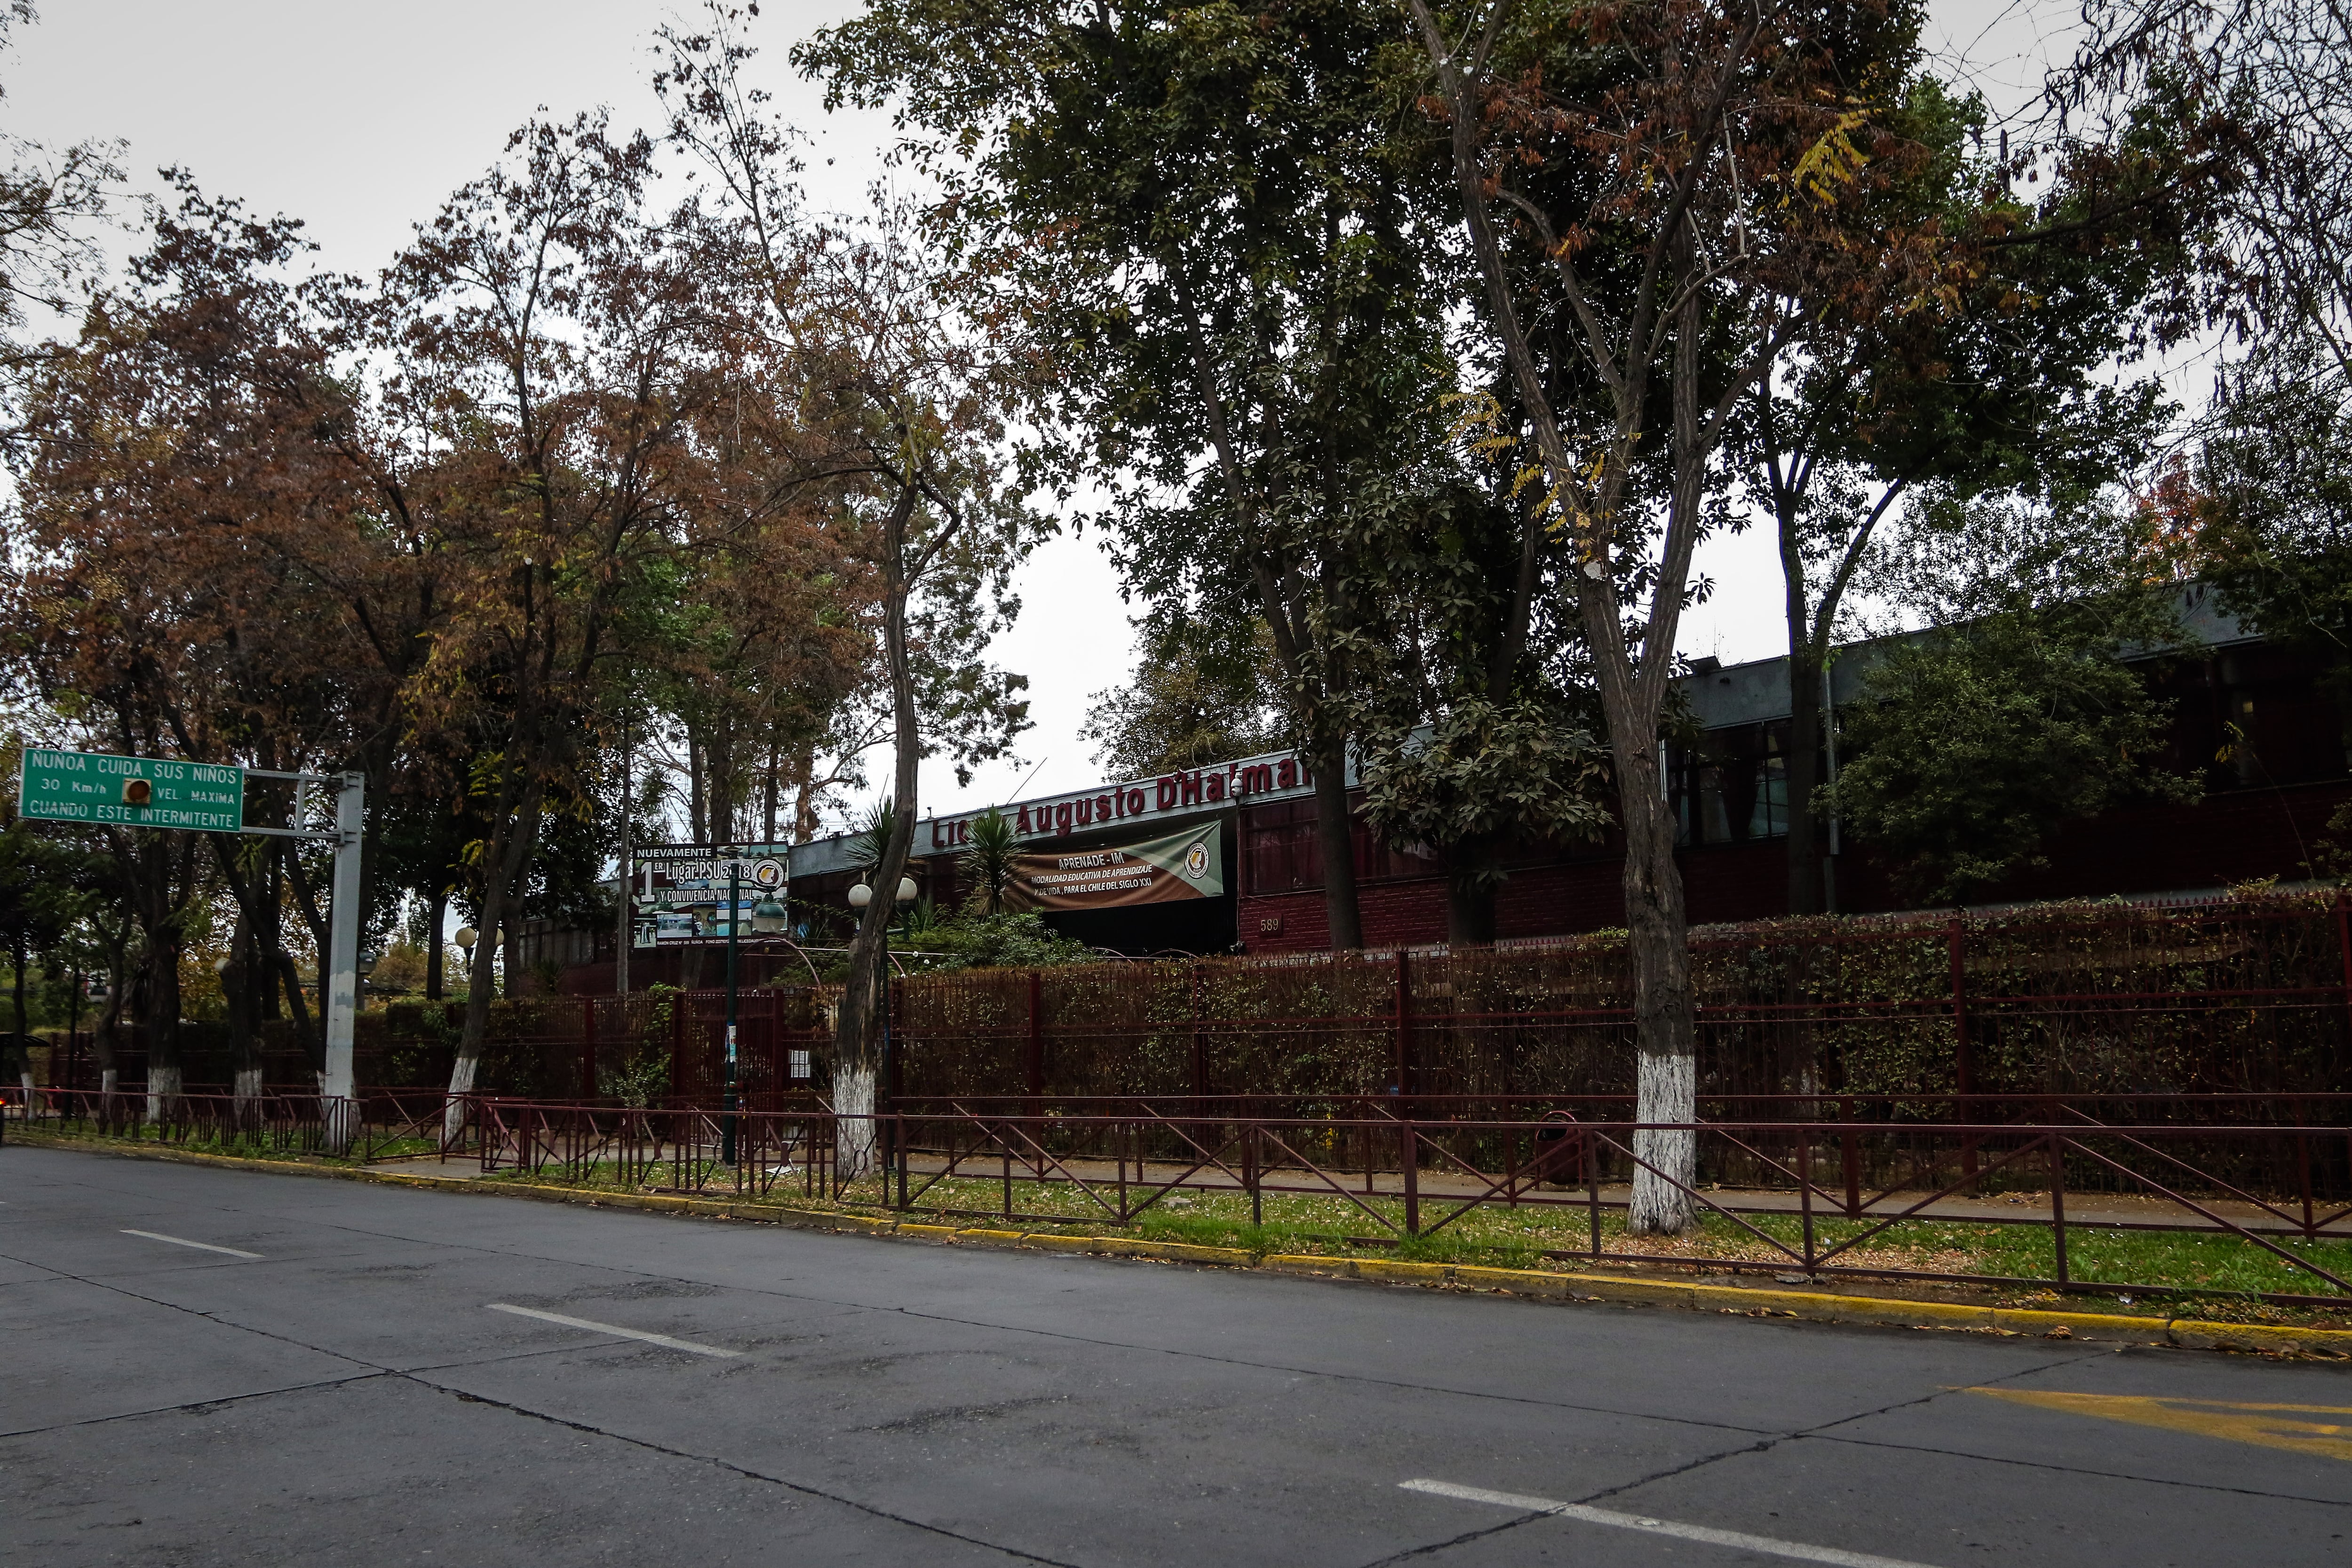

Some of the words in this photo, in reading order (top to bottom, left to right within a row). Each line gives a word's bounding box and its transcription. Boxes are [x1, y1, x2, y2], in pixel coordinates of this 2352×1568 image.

[32, 751, 86, 772] ÑUÑOA
[97, 758, 143, 776] CUIDA
[154, 764, 184, 779] SUS
[193, 766, 236, 784] NIÑOS
[41, 778, 61, 790] 30
[72, 781, 107, 794] Km/h
[191, 790, 235, 804] MAXIMA
[30, 800, 88, 817] CUANDO
[96, 805, 133, 820] ESTE
[141, 808, 234, 828] INTERMITENTE
[1015, 786, 1145, 836] Augusto
[637, 848, 711, 858] NUEVAMENTE
[1059, 854, 1105, 870] APRENADE
[1111, 852, 1125, 864] IM
[666, 862, 696, 884] Lugar
[699, 861, 720, 879] PSU
[722, 866, 750, 879] 218
[1032, 874, 1067, 884] MODALIDAD
[1067, 870, 1101, 882] EDUCATIVA
[1102, 869, 1111, 878] DE
[1111, 864, 1152, 877] APRENDIZAJE
[660, 891, 665, 902] Y
[667, 890, 715, 902] CONVIVENCIA
[717, 889, 754, 900] NACNAL
[1064, 884, 1079, 894] PARA
[1088, 883, 1105, 892] CHILE
[1106, 881, 1119, 890] DEL
[1119, 879, 1139, 889] SIGLO
[1139, 877, 1152, 887] XXI
[1261, 919, 1279, 931] 589
